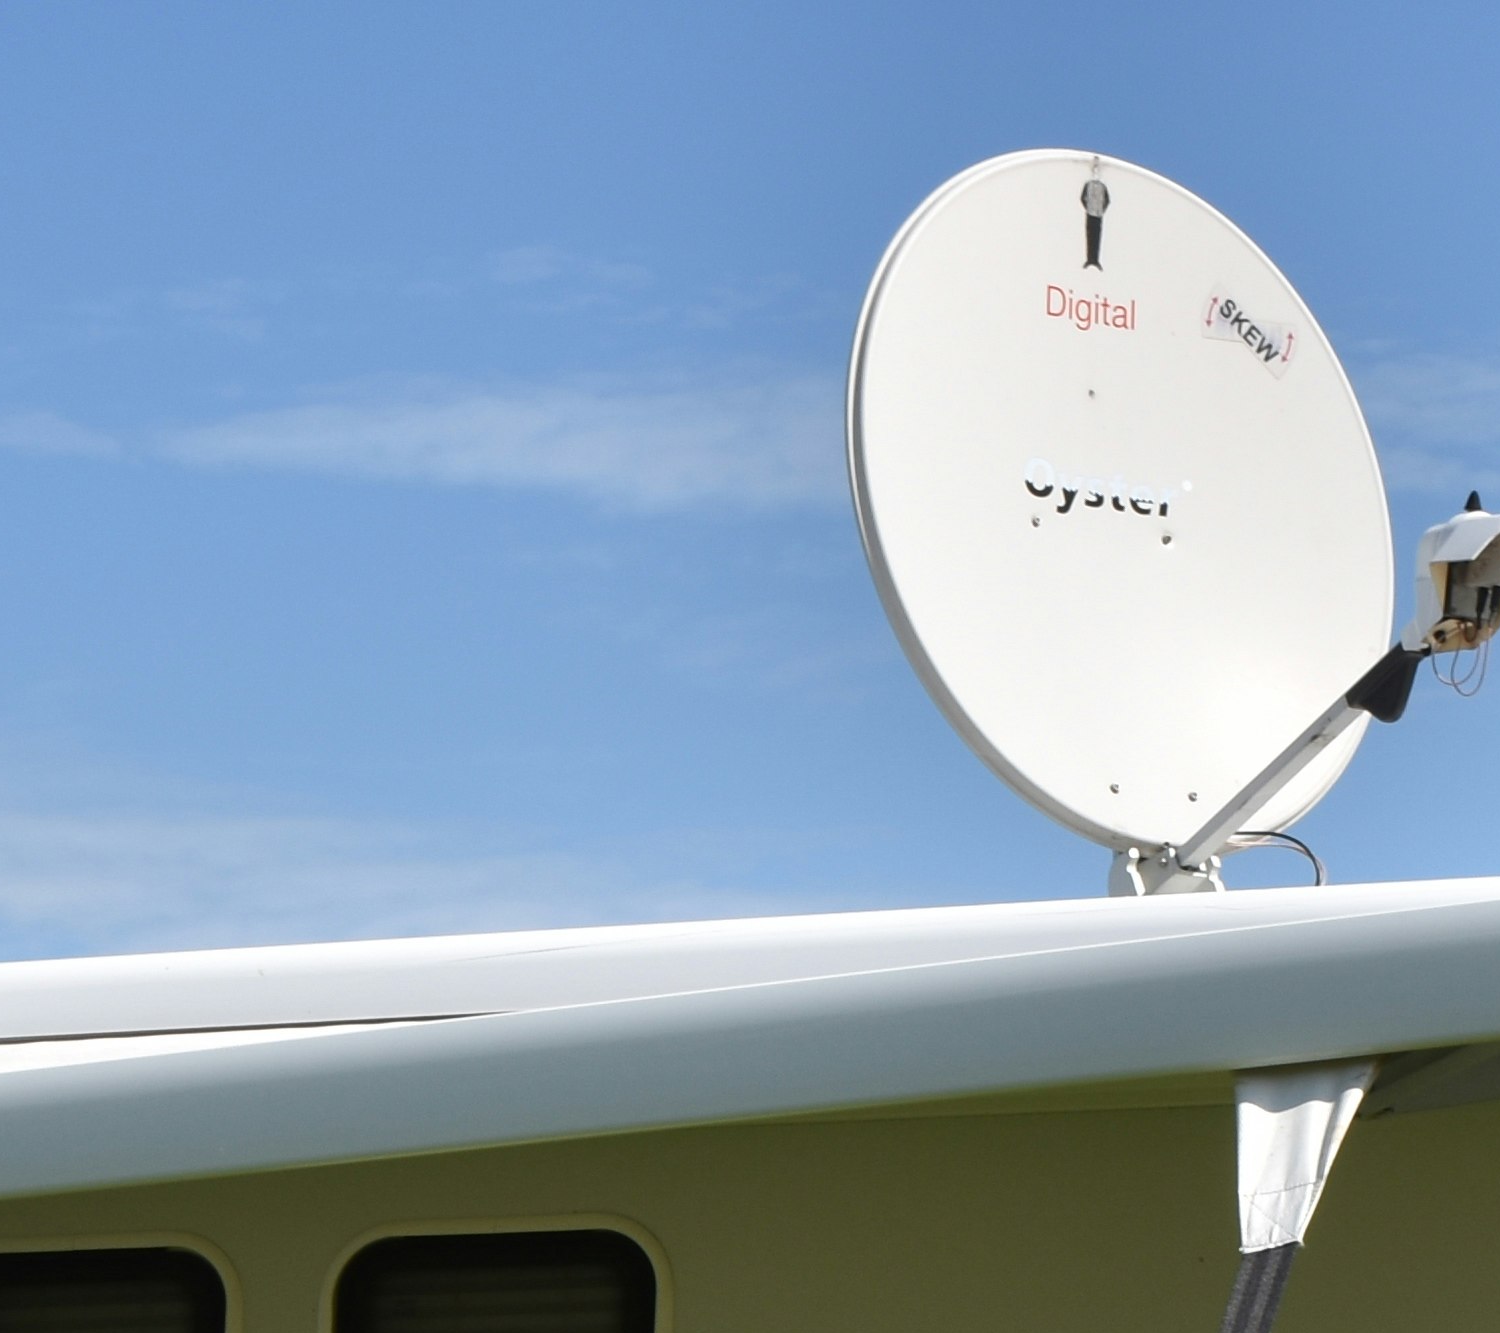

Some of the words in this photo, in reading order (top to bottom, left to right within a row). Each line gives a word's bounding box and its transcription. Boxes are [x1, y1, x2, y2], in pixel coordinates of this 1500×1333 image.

[1046, 284, 1136, 331] Digital
[1219, 298, 1280, 363] SKEW
[1024, 458, 1175, 517] Oyster
